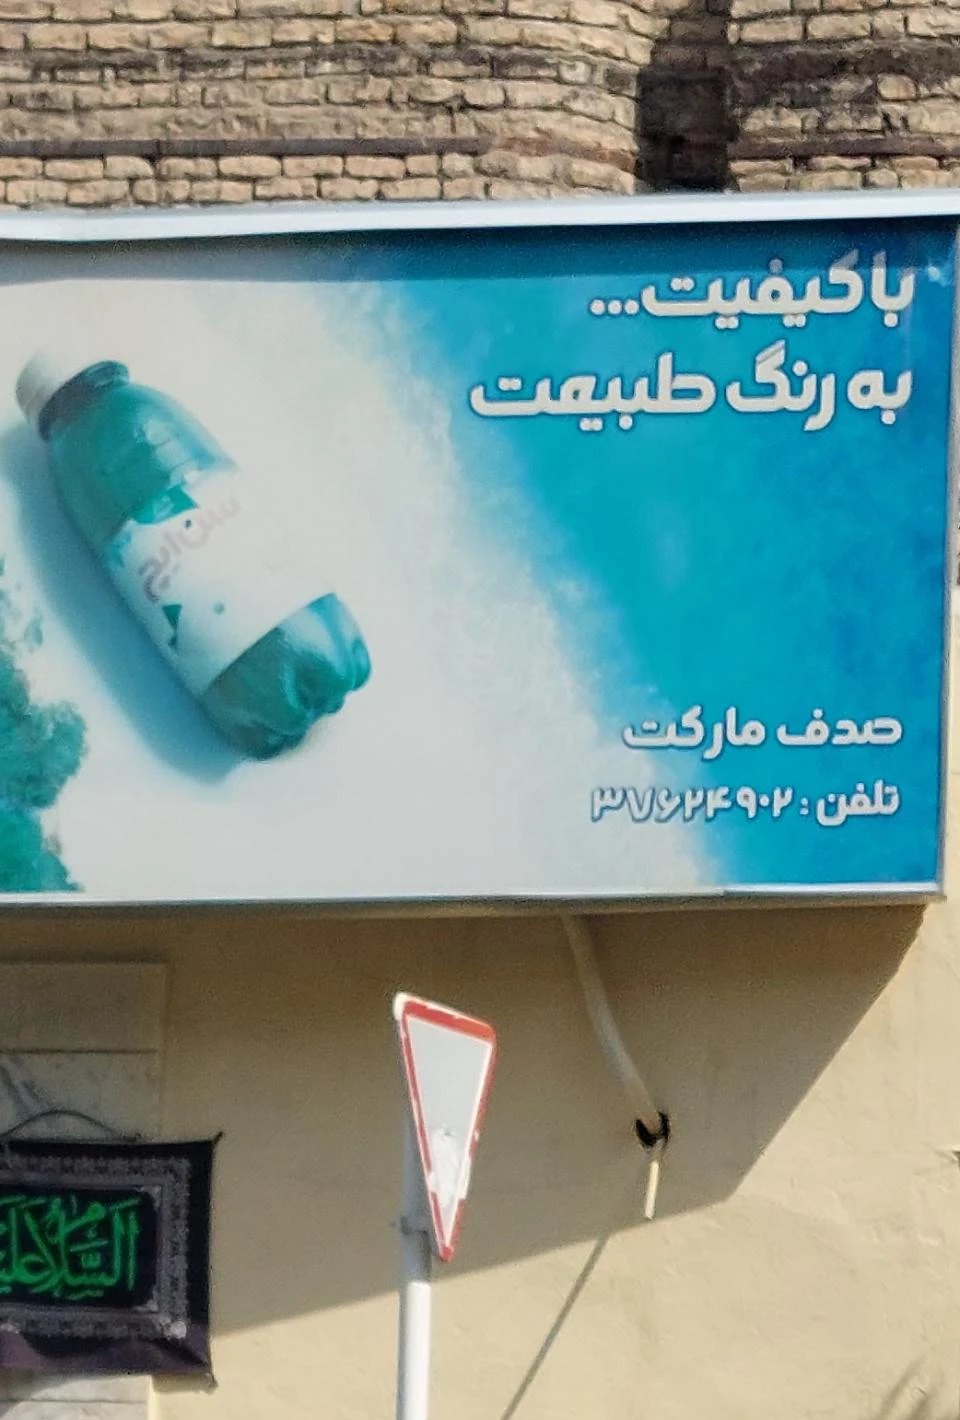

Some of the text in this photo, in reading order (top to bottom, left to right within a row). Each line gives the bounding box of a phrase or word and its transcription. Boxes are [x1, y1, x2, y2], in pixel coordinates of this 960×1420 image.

[469, 339, 913, 433] به رنگ طبیعت
[622, 703, 904, 761] صدف مارکت
[590, 785, 795, 824] ۳۷۶۲۴۹۰۲
[815, 778, 901, 828] تلفن
